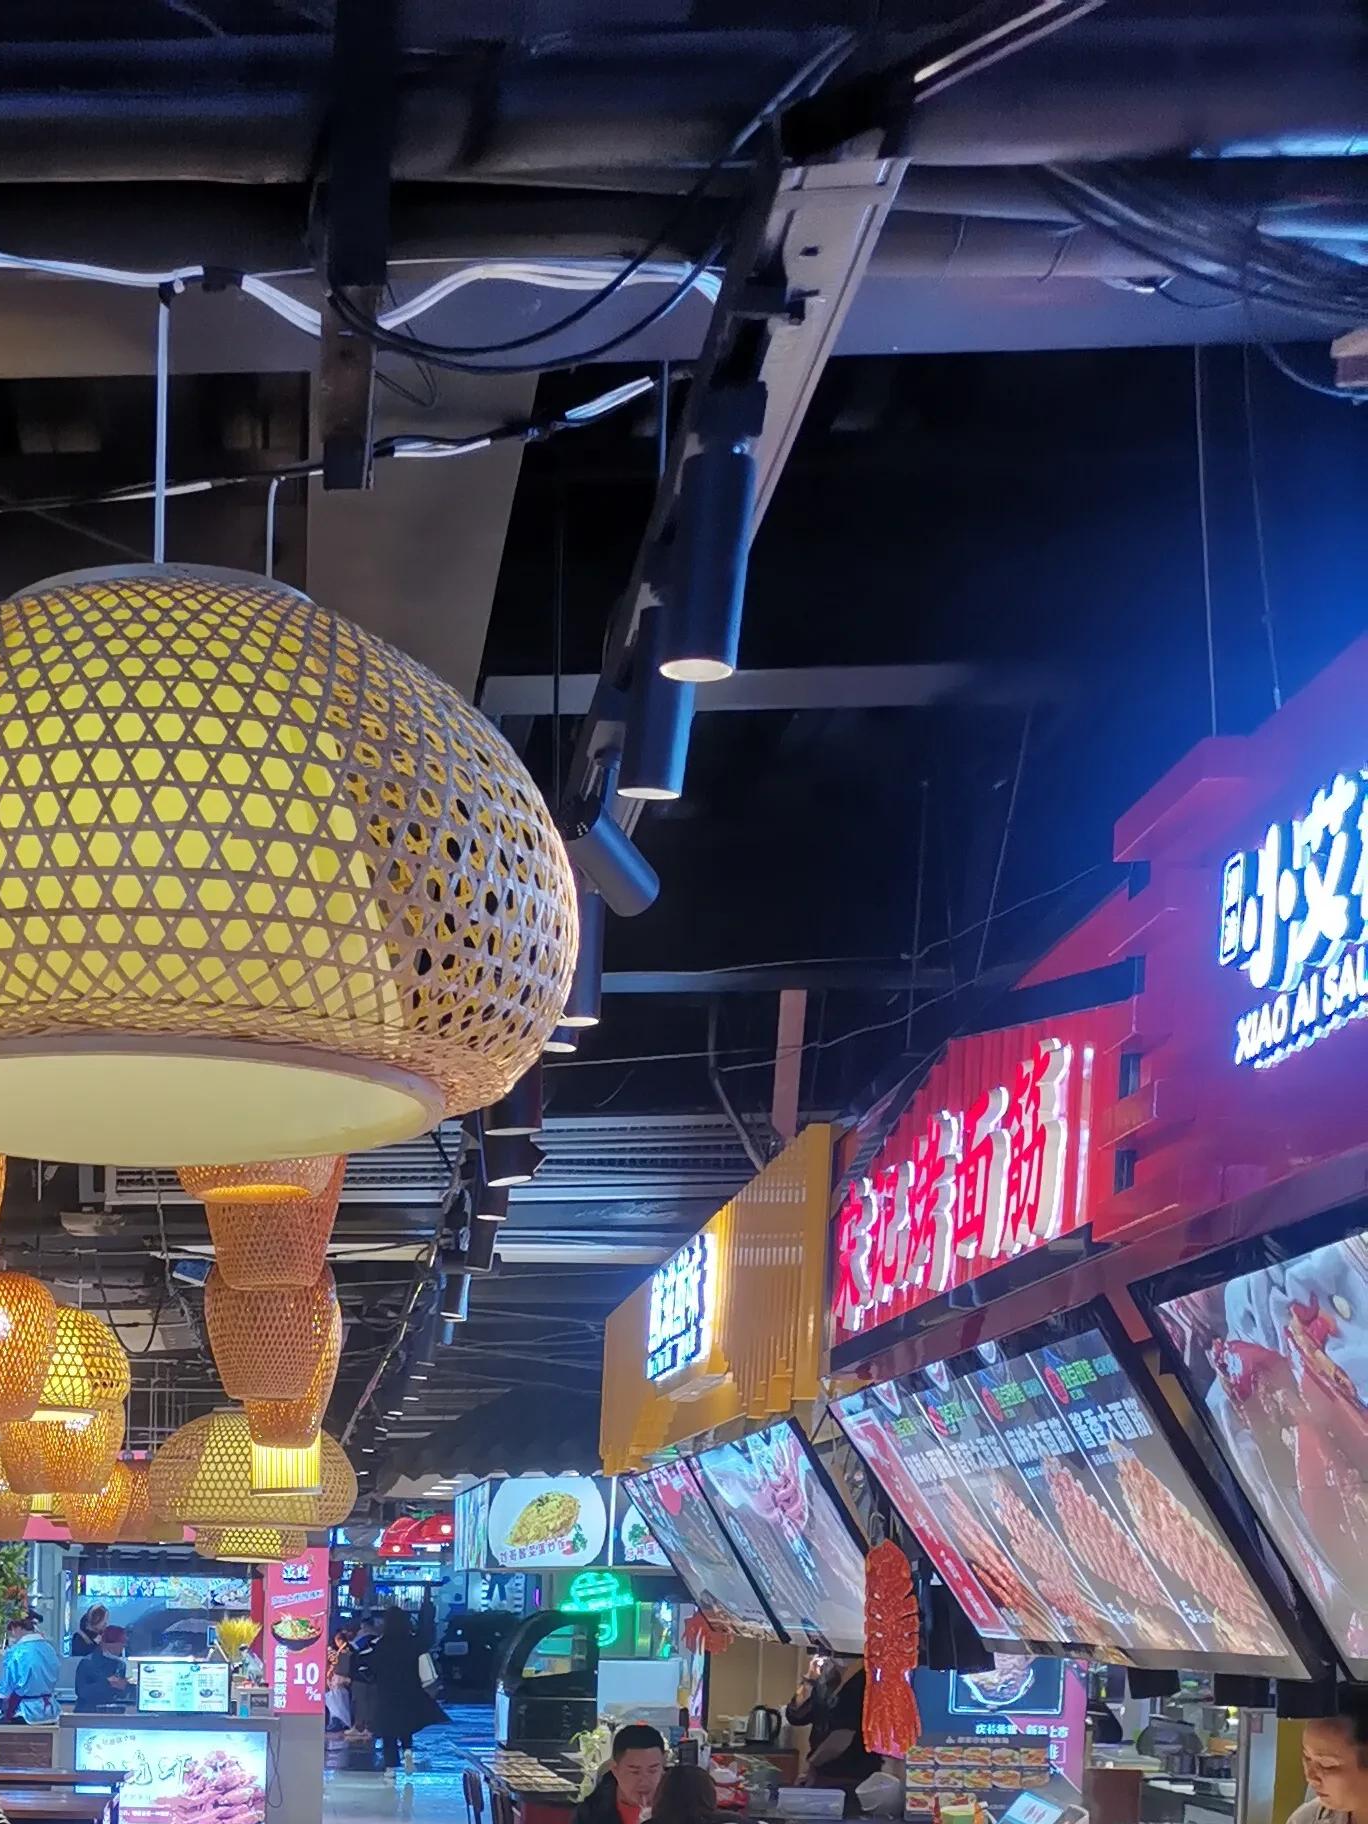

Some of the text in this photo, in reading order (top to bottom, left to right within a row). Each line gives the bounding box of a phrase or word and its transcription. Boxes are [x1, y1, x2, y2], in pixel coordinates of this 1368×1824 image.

[1240, 768, 1368, 989] 小艾
[1235, 994, 1288, 1066] XIAO
[1291, 972, 1319, 1034] AI
[293, 1662, 319, 1685] 10
